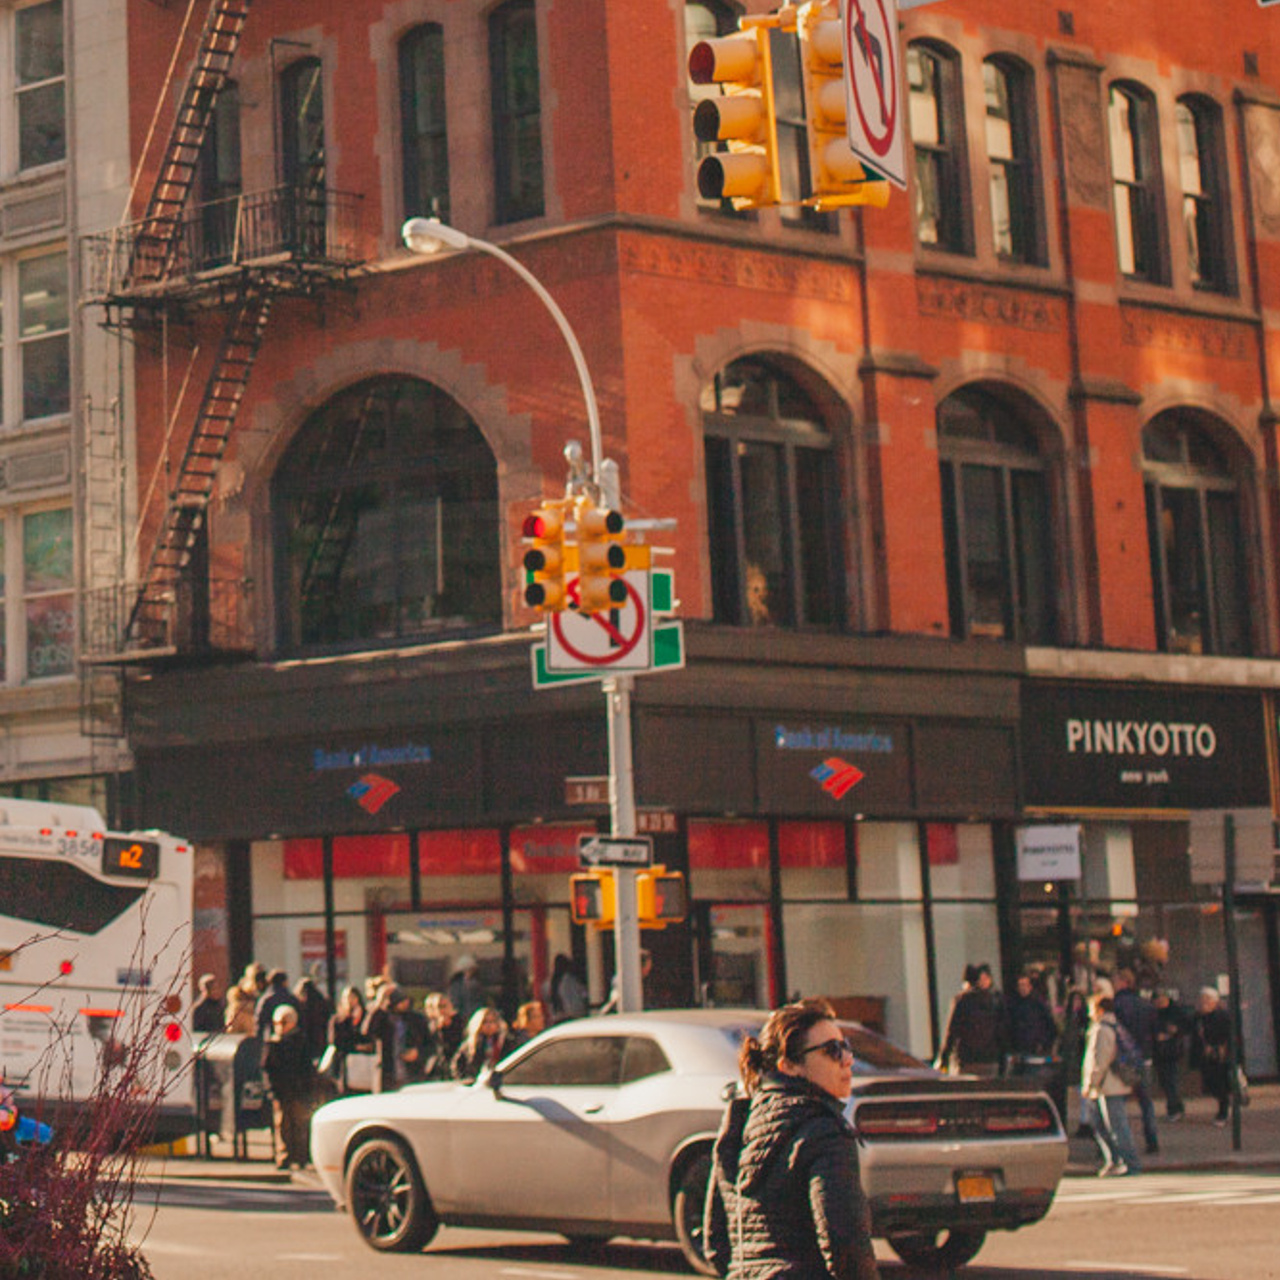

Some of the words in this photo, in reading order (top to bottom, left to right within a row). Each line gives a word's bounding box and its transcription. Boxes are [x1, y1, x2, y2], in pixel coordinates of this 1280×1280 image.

[775, 724, 812, 749] Bank
[832, 725, 893, 753] America
[1066, 718, 1217, 758] PINKYOTTO
[313, 747, 350, 771] Bank
[370, 742, 431, 765] America
